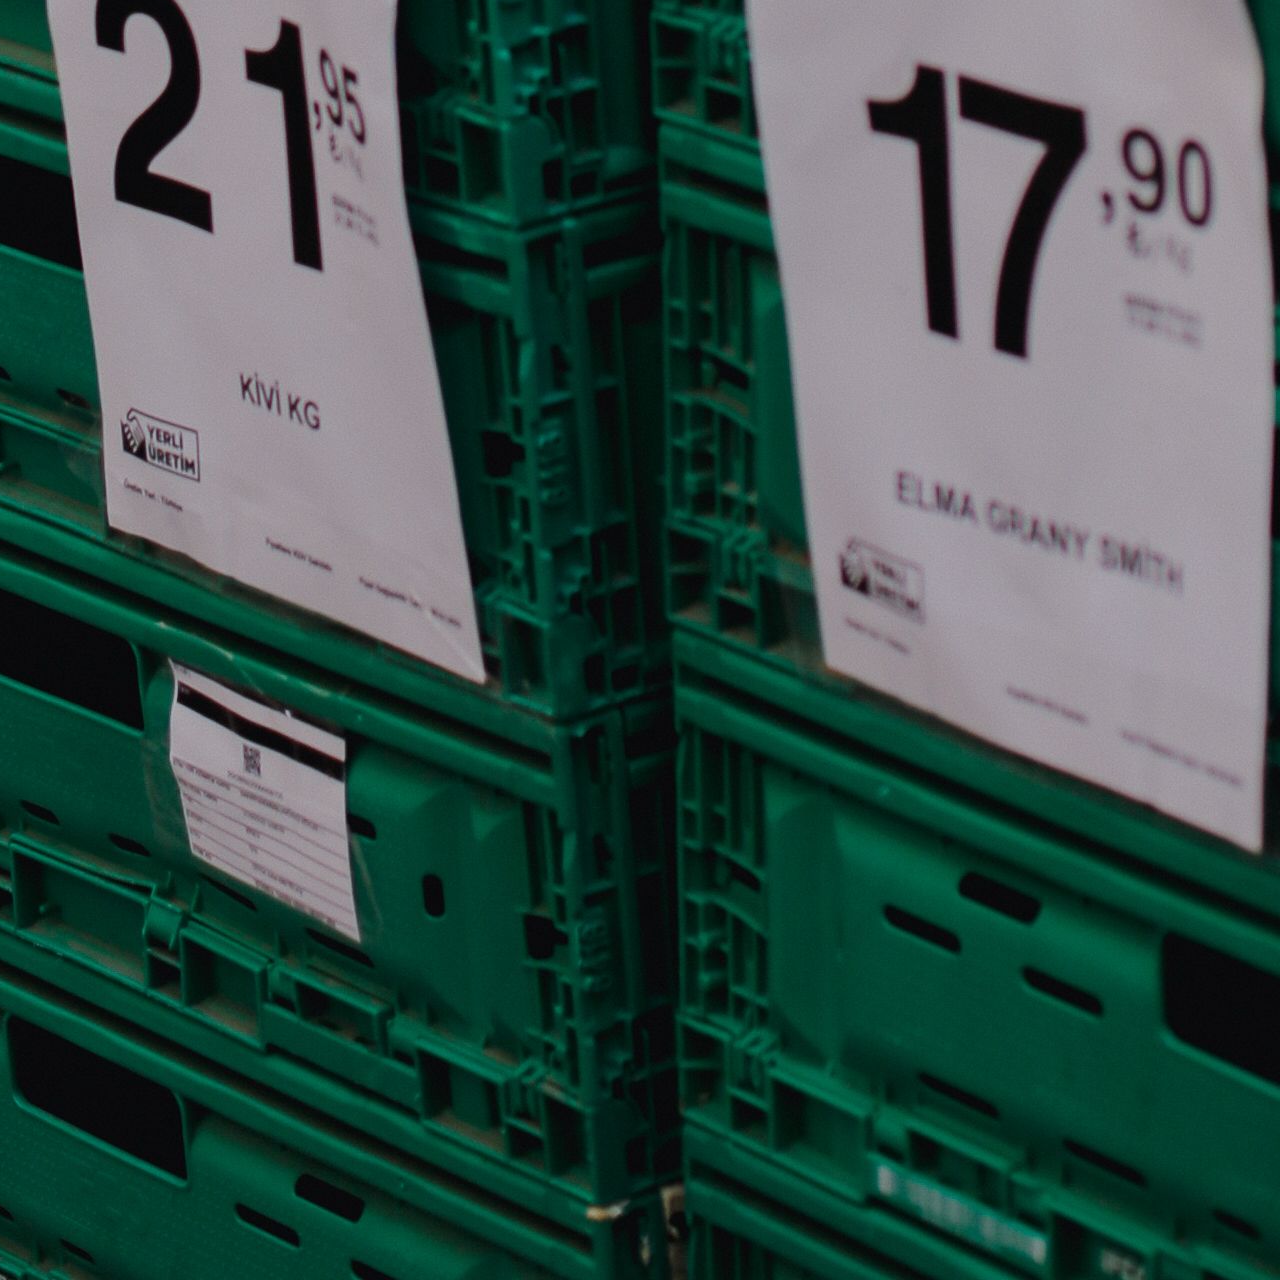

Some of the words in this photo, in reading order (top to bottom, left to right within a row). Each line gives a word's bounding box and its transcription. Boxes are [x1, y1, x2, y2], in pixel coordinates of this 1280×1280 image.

[239, 371, 282, 417] KİVİ
[287, 392, 321, 431] KG
[147, 423, 184, 451] YERLİ
[148, 441, 196, 475] ÜRETİM
[896, 470, 977, 525] ELMA
[987, 499, 1088, 559] GRANY
